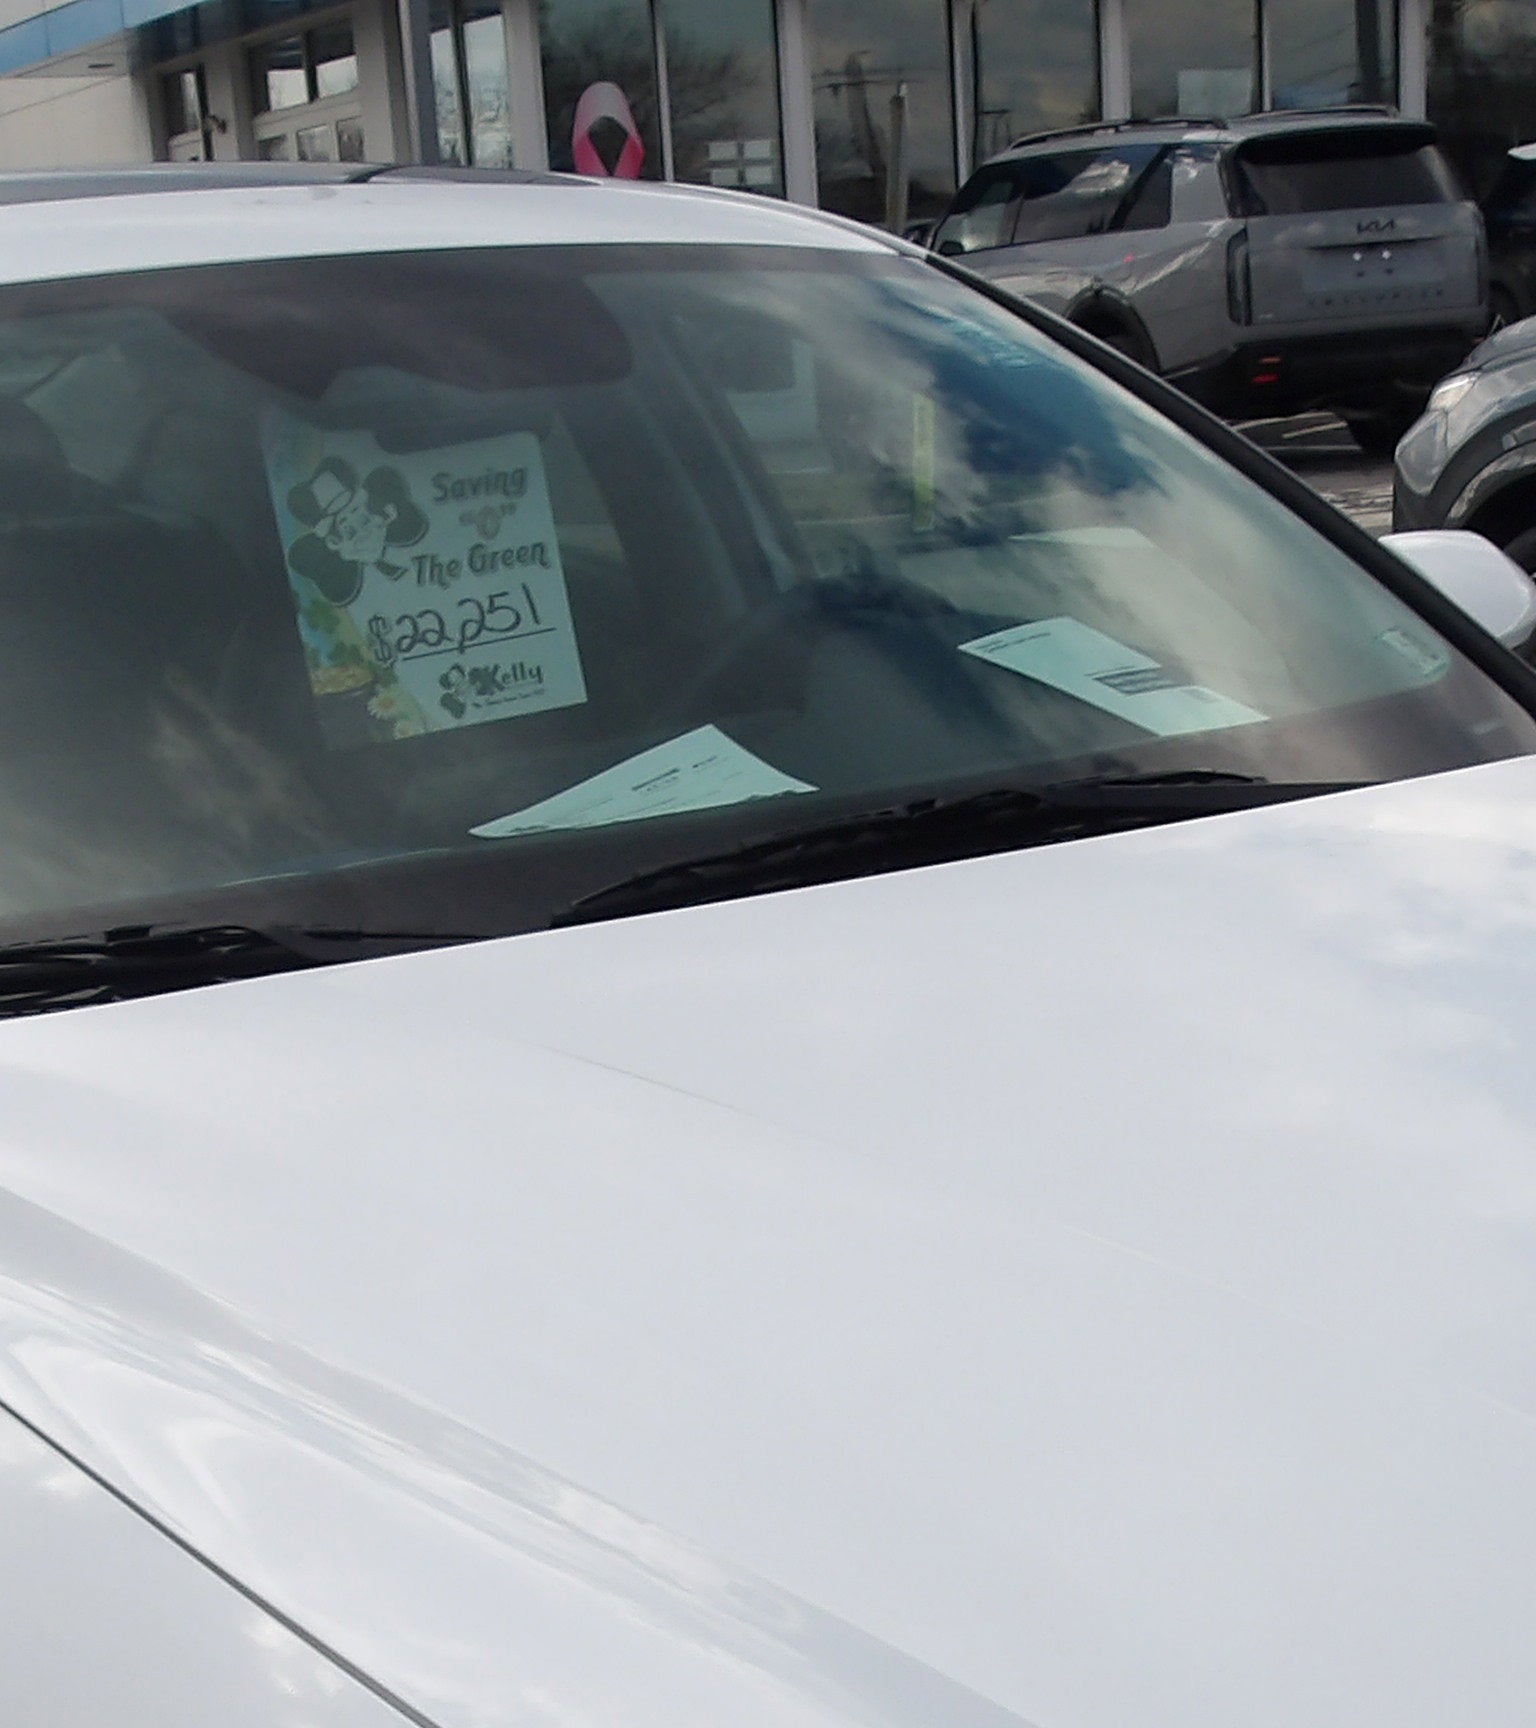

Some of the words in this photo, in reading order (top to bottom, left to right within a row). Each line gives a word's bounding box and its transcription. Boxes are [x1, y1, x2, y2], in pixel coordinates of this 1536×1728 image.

[430, 467, 527, 503] Saving
[412, 553, 461, 590] The
[467, 542, 551, 576] Green
